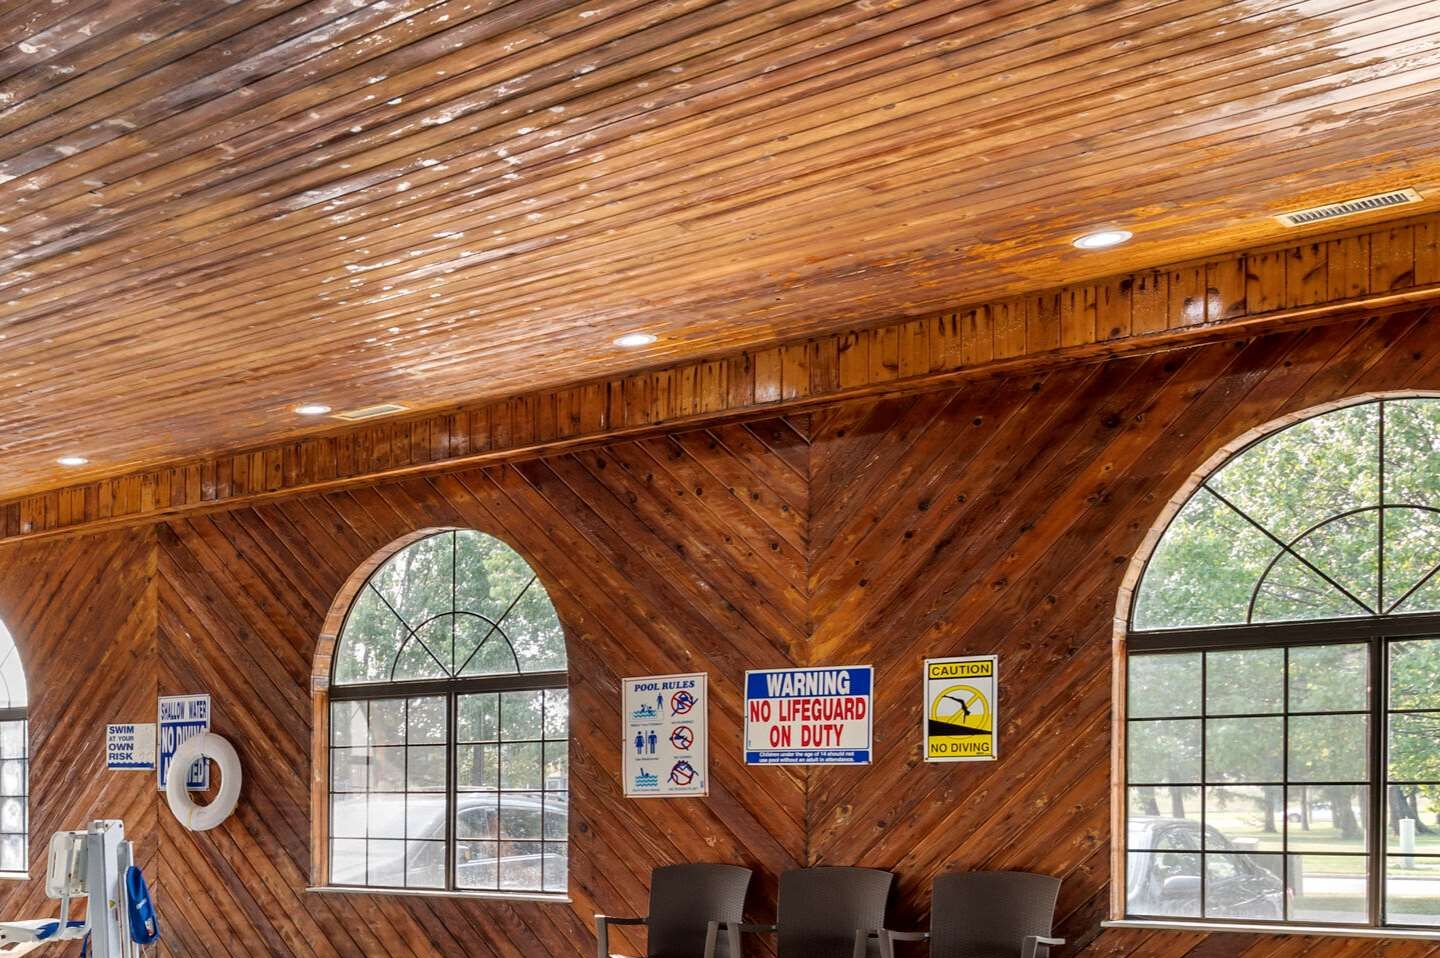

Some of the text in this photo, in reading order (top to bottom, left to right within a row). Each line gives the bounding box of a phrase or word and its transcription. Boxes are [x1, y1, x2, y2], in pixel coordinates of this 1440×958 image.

[931, 664, 990, 676] CAUTION
[634, 680, 695, 692] POOL RULES
[766, 670, 851, 697] WARNING
[161, 701, 207, 720] SHALLOW WATER
[750, 697, 866, 722] NO LIFEGUARD
[109, 726, 135, 735] SWIM
[769, 724, 845, 748] ON DUTY
[161, 726, 174, 753] NO
[108, 743, 134, 751] OWN
[931, 742, 990, 753] NO DIVING
[109, 752, 133, 761] RISK
